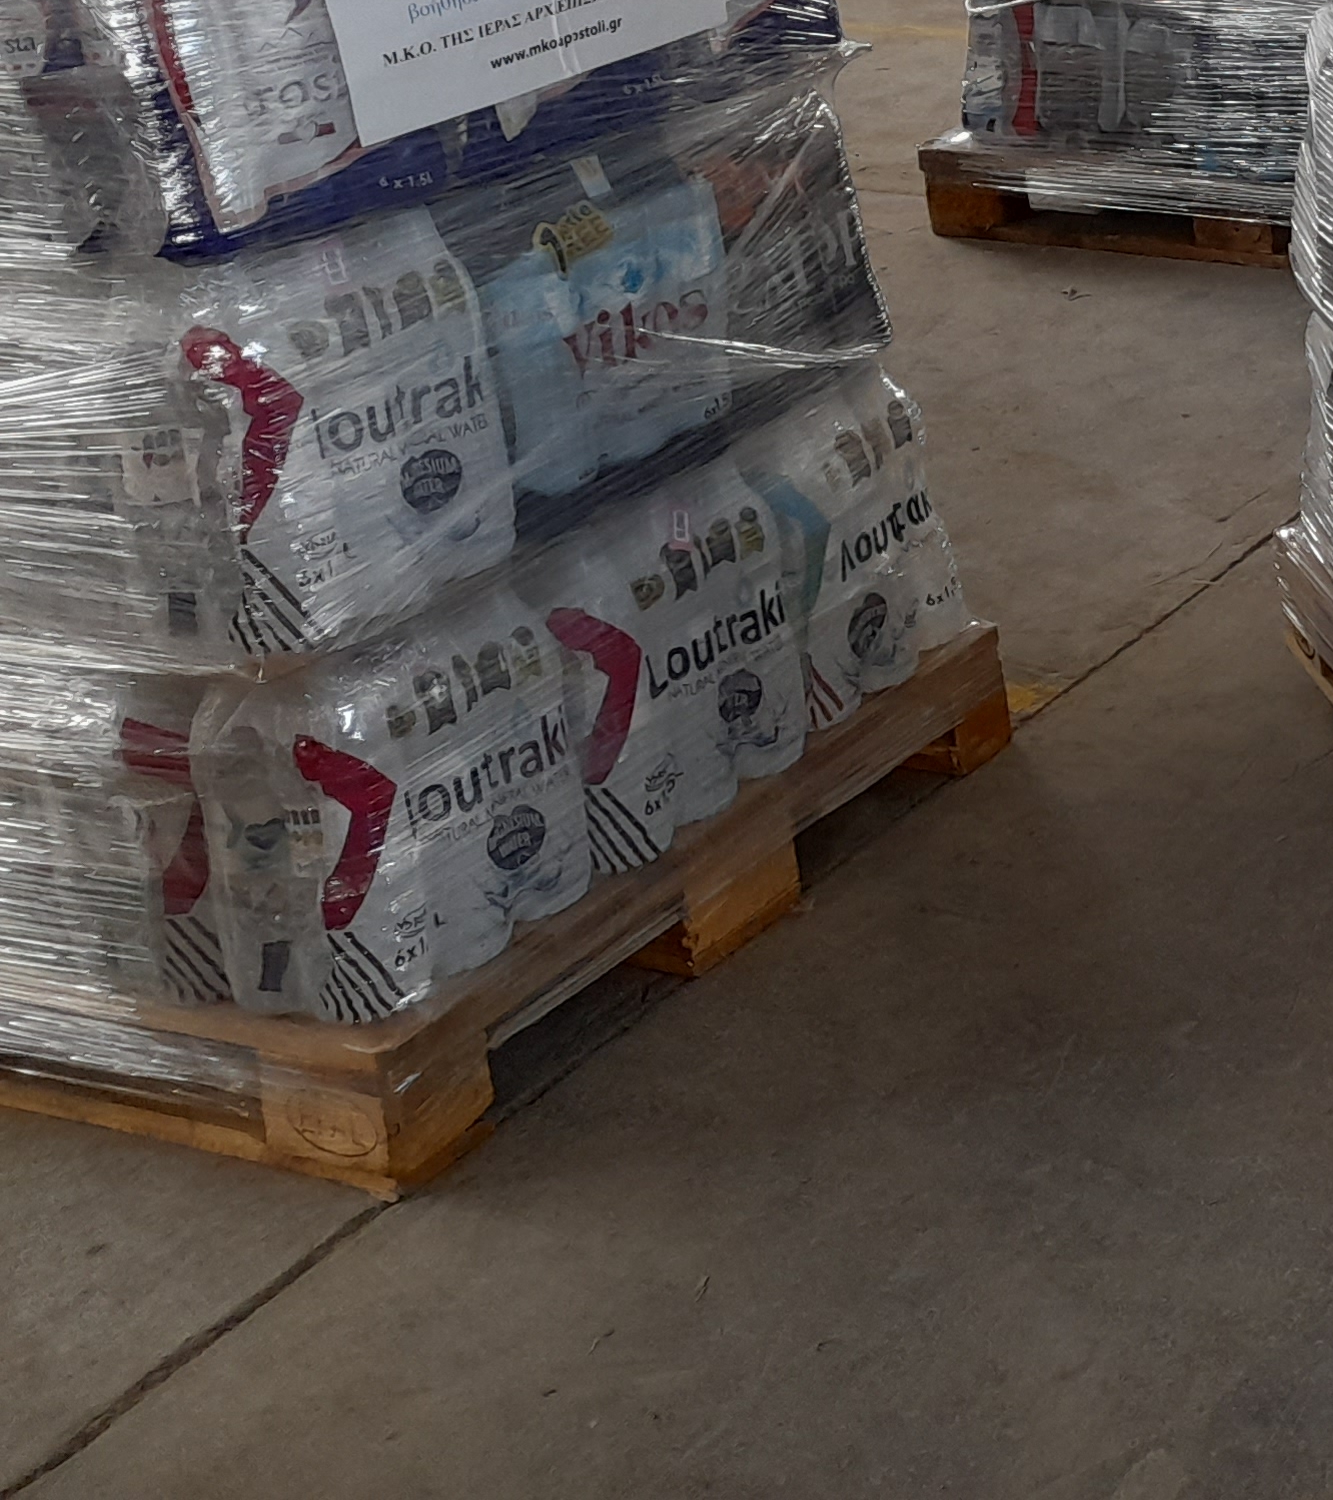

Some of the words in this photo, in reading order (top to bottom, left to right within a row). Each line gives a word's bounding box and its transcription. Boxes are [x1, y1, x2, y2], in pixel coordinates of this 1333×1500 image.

[440, 29, 475, 54] ΤΗΣ
[478, 12, 521, 39] ΙΕΡΑΣ
[646, 580, 786, 700] Loutraki
